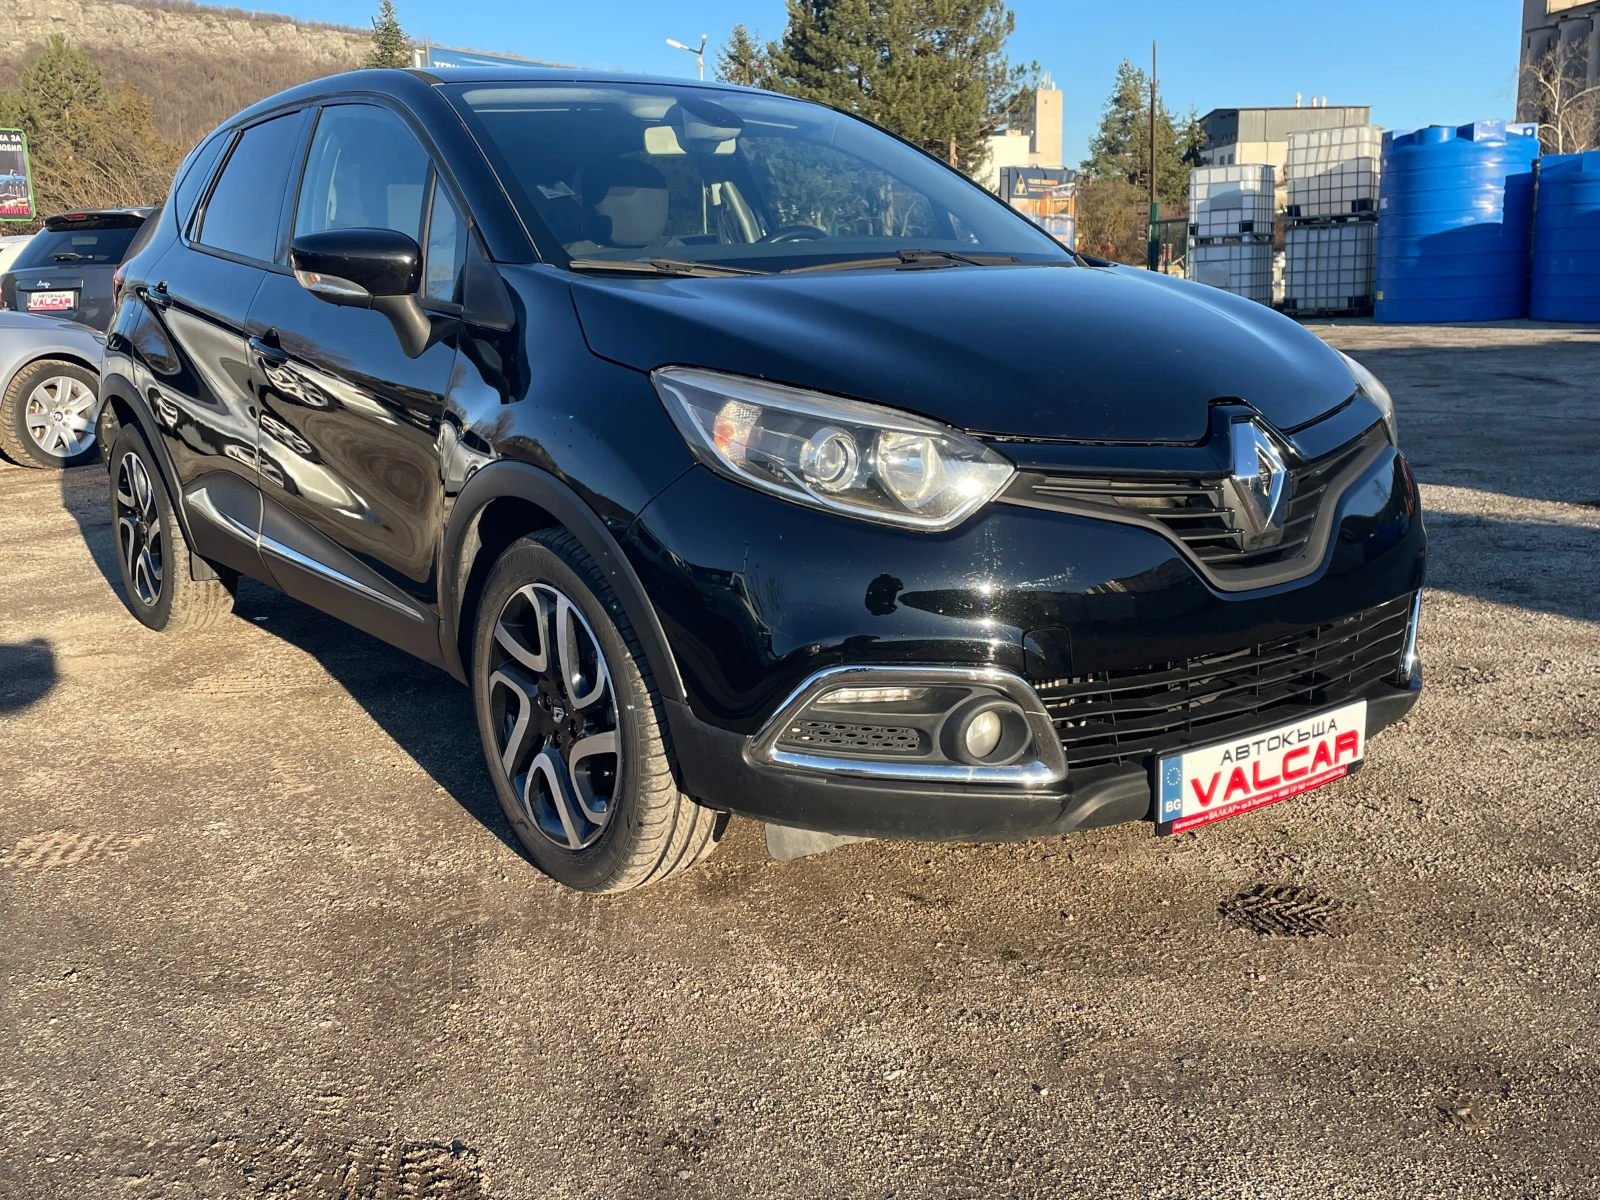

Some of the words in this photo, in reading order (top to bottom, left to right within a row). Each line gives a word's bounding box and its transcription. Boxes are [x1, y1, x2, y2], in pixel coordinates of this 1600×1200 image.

[10, 134, 22, 142] ЗА
[32, 298, 72, 307] VALCAR
[1190, 729, 1359, 808] VALCAR
[1165, 798, 1182, 813] BG
